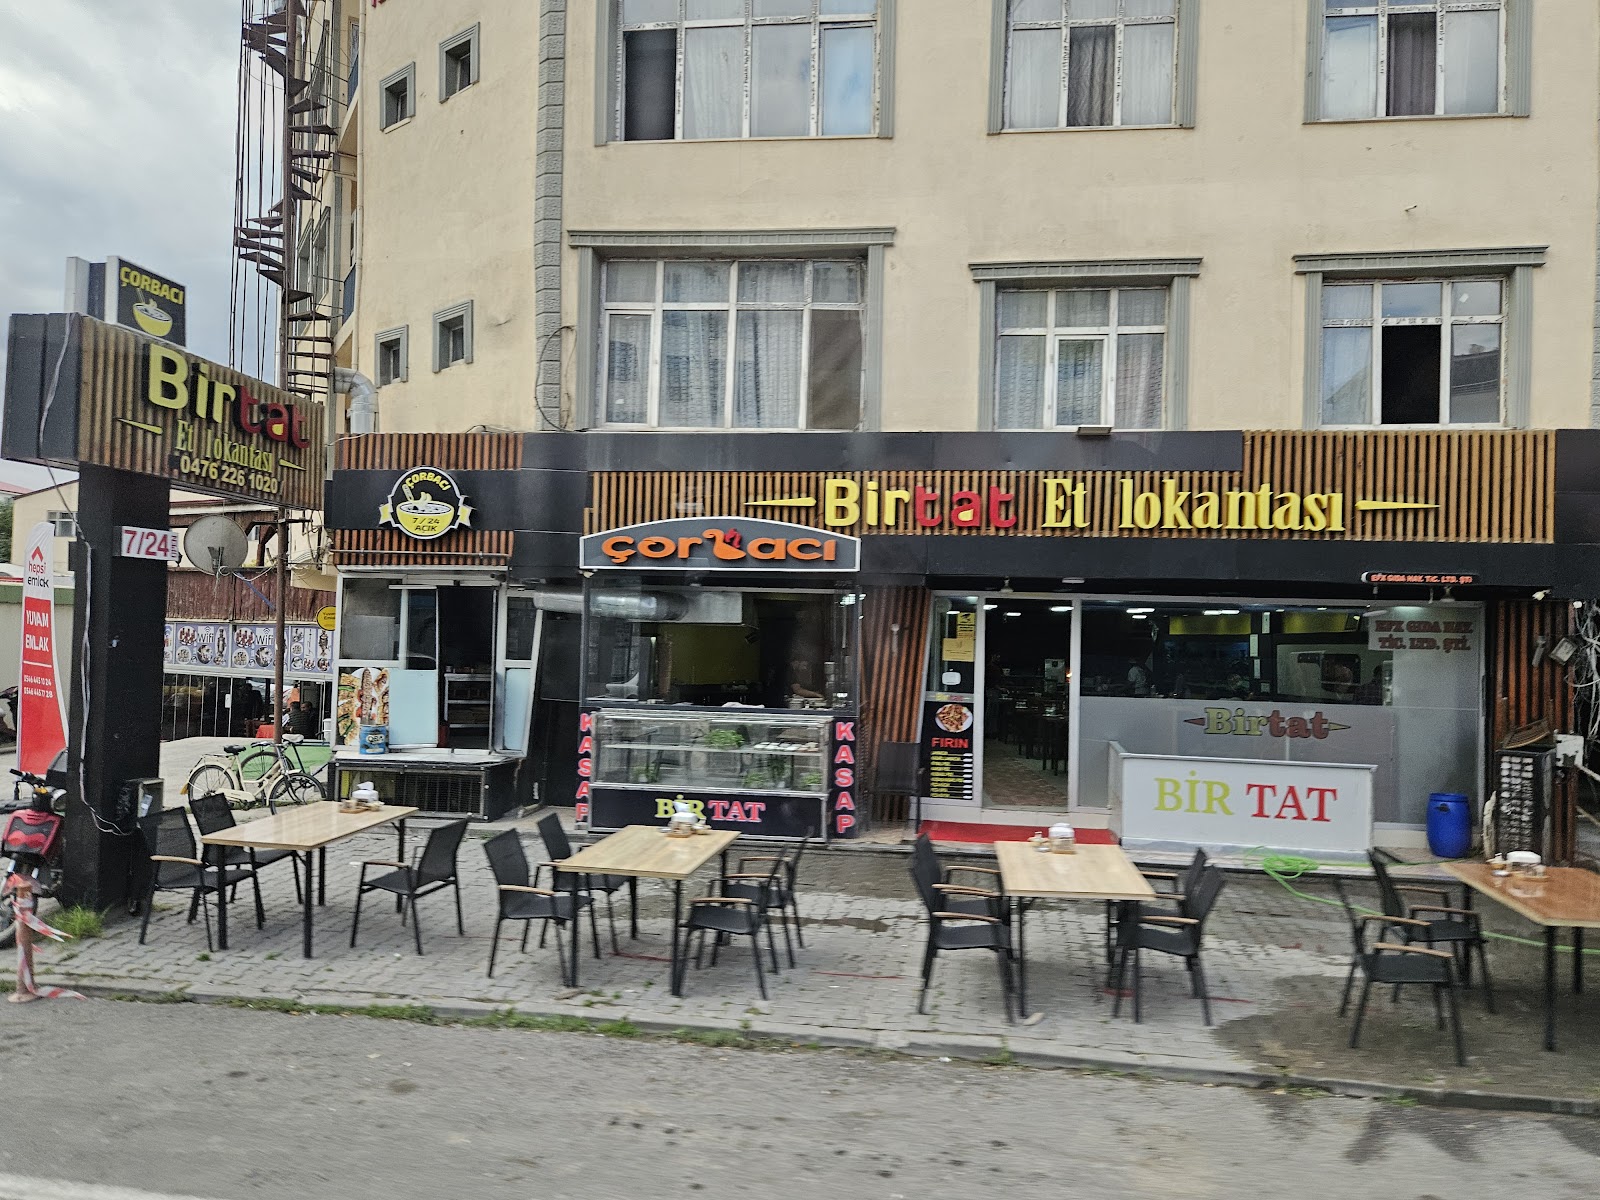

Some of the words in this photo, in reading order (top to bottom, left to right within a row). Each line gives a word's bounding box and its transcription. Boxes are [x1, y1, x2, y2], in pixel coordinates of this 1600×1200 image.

[120, 266, 184, 305] ÇORBACI
[148, 343, 310, 449] Birtat
[174, 419, 194, 452] Et
[205, 428, 273, 473] lokantası
[180, 455, 218, 480] 0476
[221, 465, 245, 487] 226
[249, 472, 278, 494] 1020
[405, 471, 452, 491] ÇORBACI
[824, 478, 1017, 529] Birtat
[1041, 478, 1091, 529] Et
[1119, 478, 1346, 532] lokantası
[124, 529, 169, 557] 7/24
[27, 576, 49, 588] emlak
[28, 560, 47, 576] hepsi
[198, 632, 214, 644] Wifi
[1204, 706, 1330, 740] Birtat
[930, 737, 969, 749] FIRIN
[834, 721, 855, 834] KASAP
[708, 800, 766, 823] TAT
[1154, 769, 1235, 816] BİR
[1246, 783, 1338, 823] TAT
